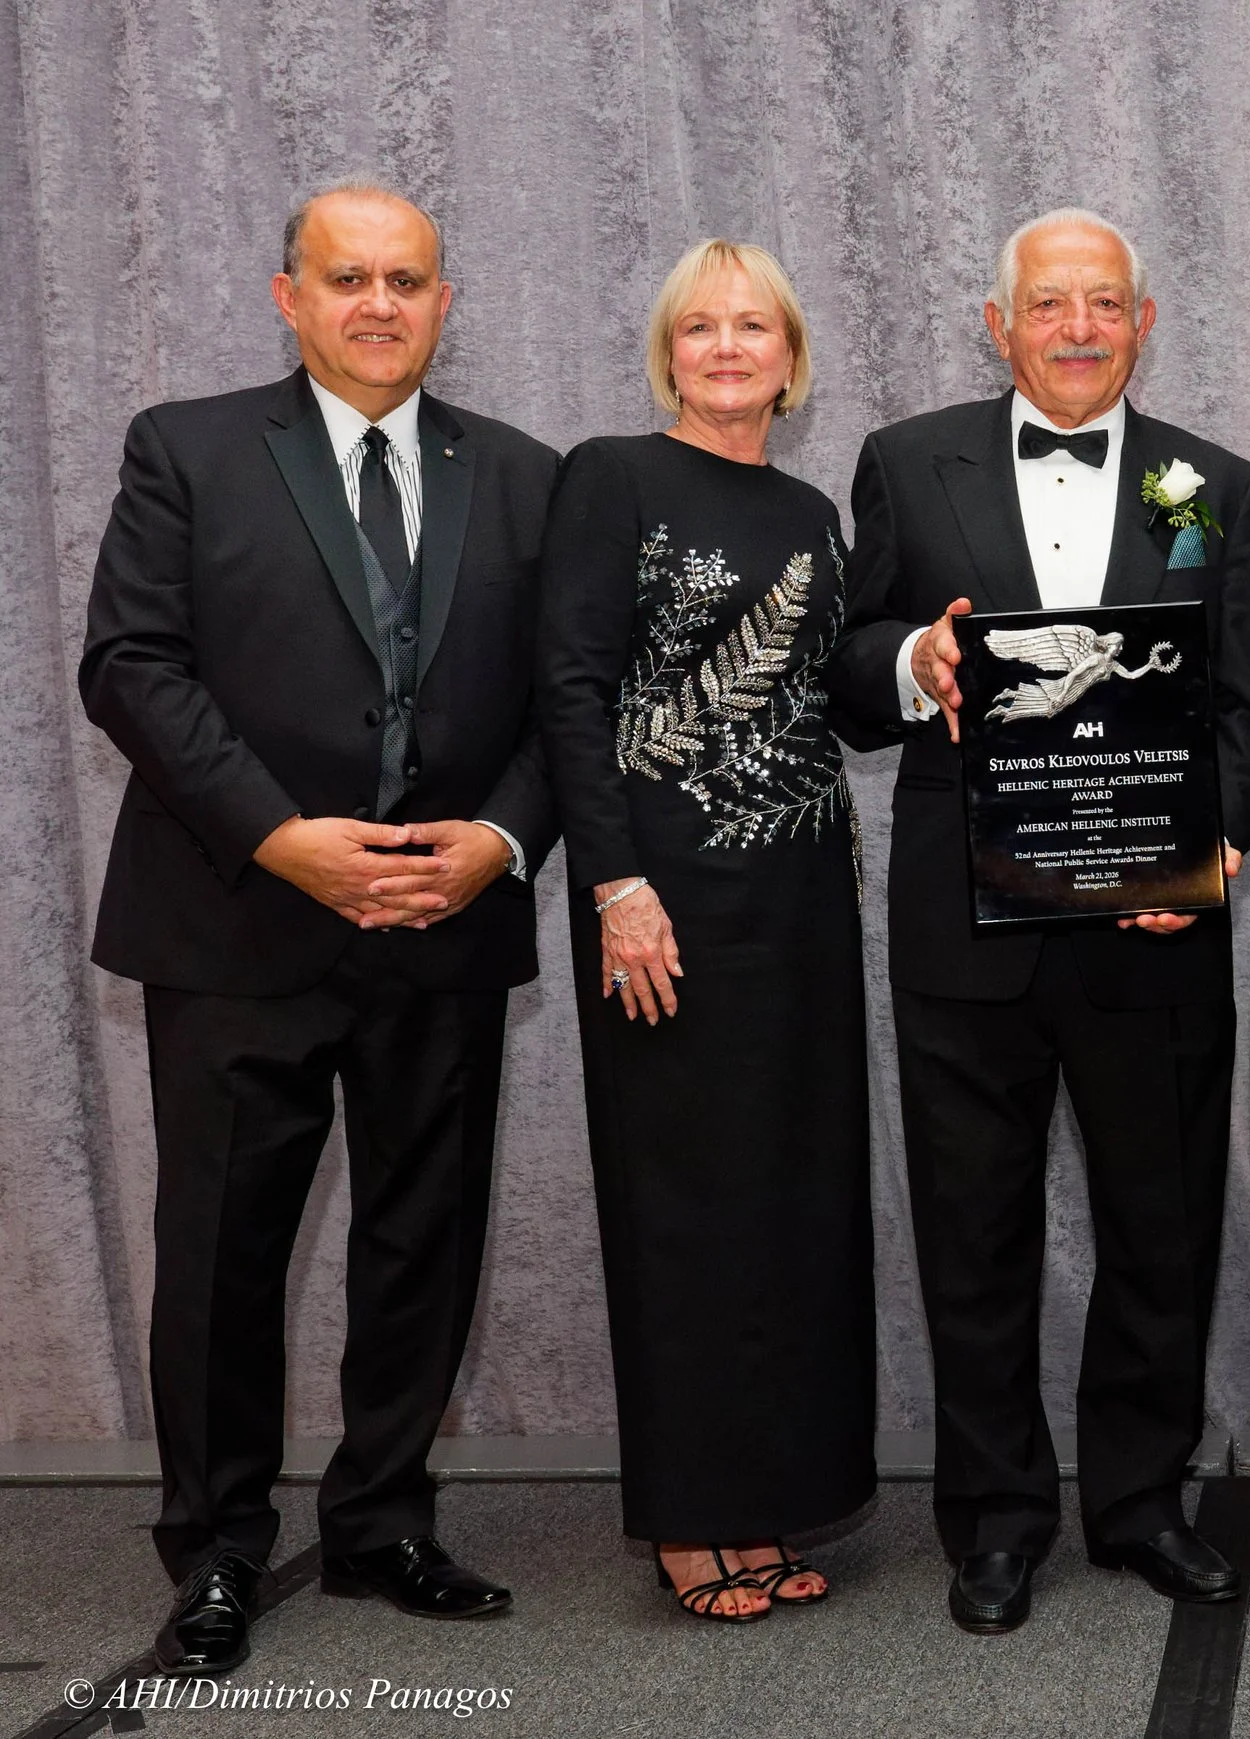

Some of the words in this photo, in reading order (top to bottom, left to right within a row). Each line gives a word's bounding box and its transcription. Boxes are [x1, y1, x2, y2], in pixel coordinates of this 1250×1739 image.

[989, 757, 1045, 771] STAVROS
[1048, 753, 1131, 768] KLEOVOULOS
[1133, 749, 1189, 763] VELETSIS
[997, 780, 1049, 792] HELLENIC
[1052, 777, 1105, 789] HERITAGE
[1108, 773, 1184, 786] ACHIEVEMENT
[1071, 790, 1113, 801] AWARD
[1016, 822, 1068, 833] AMERICAN
[1071, 819, 1118, 830] HELLENIC
[1121, 816, 1171, 827] INSTITUTE
[1070, 848, 1095, 856] Hellenic
[1124, 845, 1163, 853] Achievement
[1164, 843, 1176, 851] and
[1035, 860, 1063, 868] National
[1110, 856, 1134, 864] Awards
[1075, 872, 1095, 880] March
[1104, 871, 1119, 879] 2026
[1109, 880, 1123, 888] D.C.
